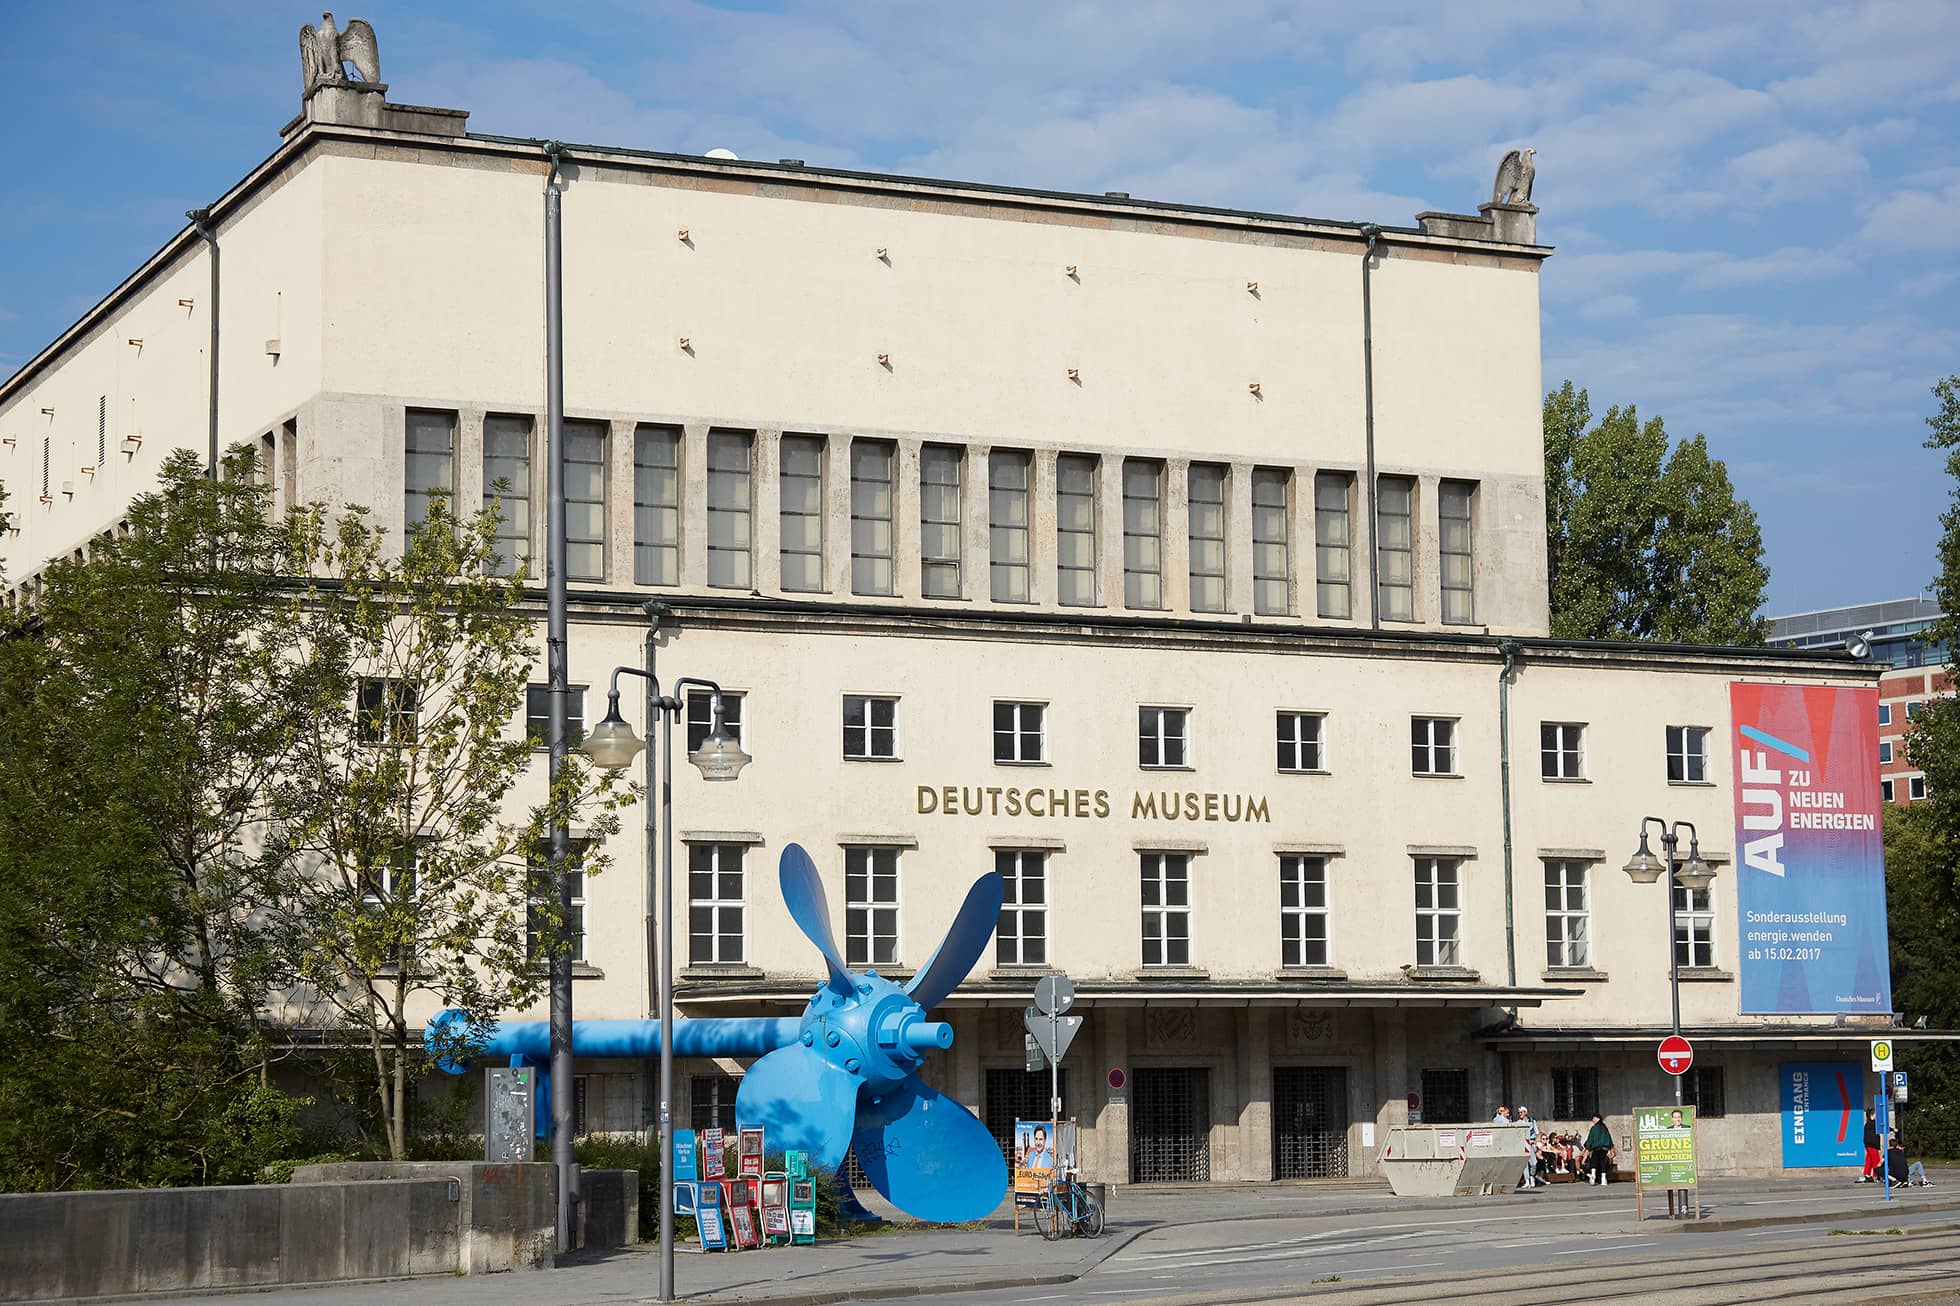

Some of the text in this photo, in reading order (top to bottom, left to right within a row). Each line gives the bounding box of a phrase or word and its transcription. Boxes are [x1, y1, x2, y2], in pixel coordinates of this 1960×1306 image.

[1789, 770, 1810, 786] ZU
[917, 785, 1271, 823] DEUTSCHES MUSEUM
[1790, 792, 1844, 809] NEUEN
[1790, 813, 1874, 830] ENERGIEN
[1747, 911, 1847, 926] Sonderausstellung
[1747, 930, 1832, 943] energie.wenden
[1748, 948, 1821, 960] ab 15.02.2017
[1877, 1045, 1886, 1057] H
[1793, 1072, 1805, 1144] EINGANG
